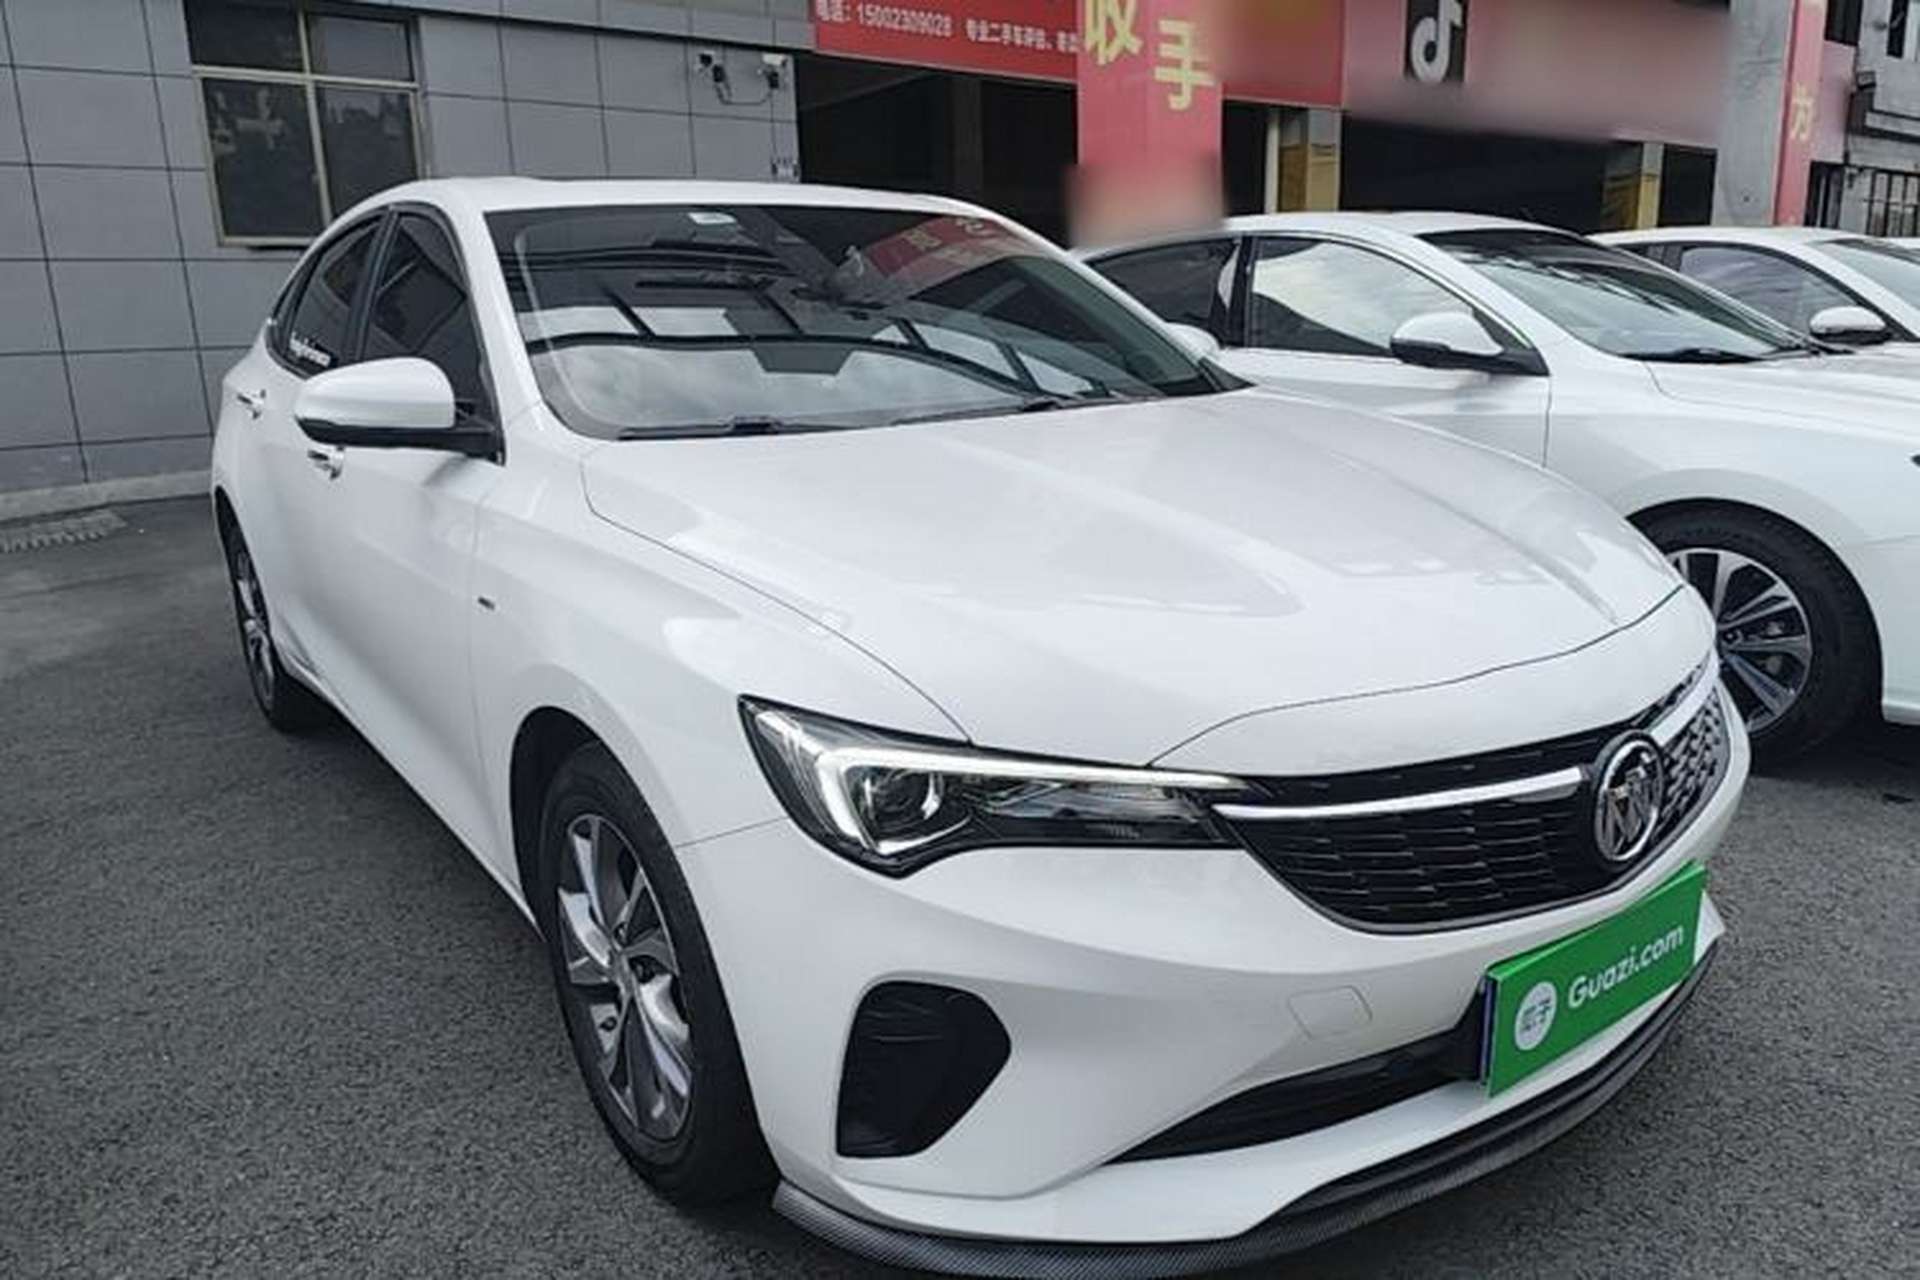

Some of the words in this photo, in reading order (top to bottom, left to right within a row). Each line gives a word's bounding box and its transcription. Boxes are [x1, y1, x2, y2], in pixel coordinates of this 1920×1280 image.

[1085, 0, 1143, 66] 收
[1154, 19, 1215, 110] 手
[1568, 925, 1684, 1008] Guazi.com
